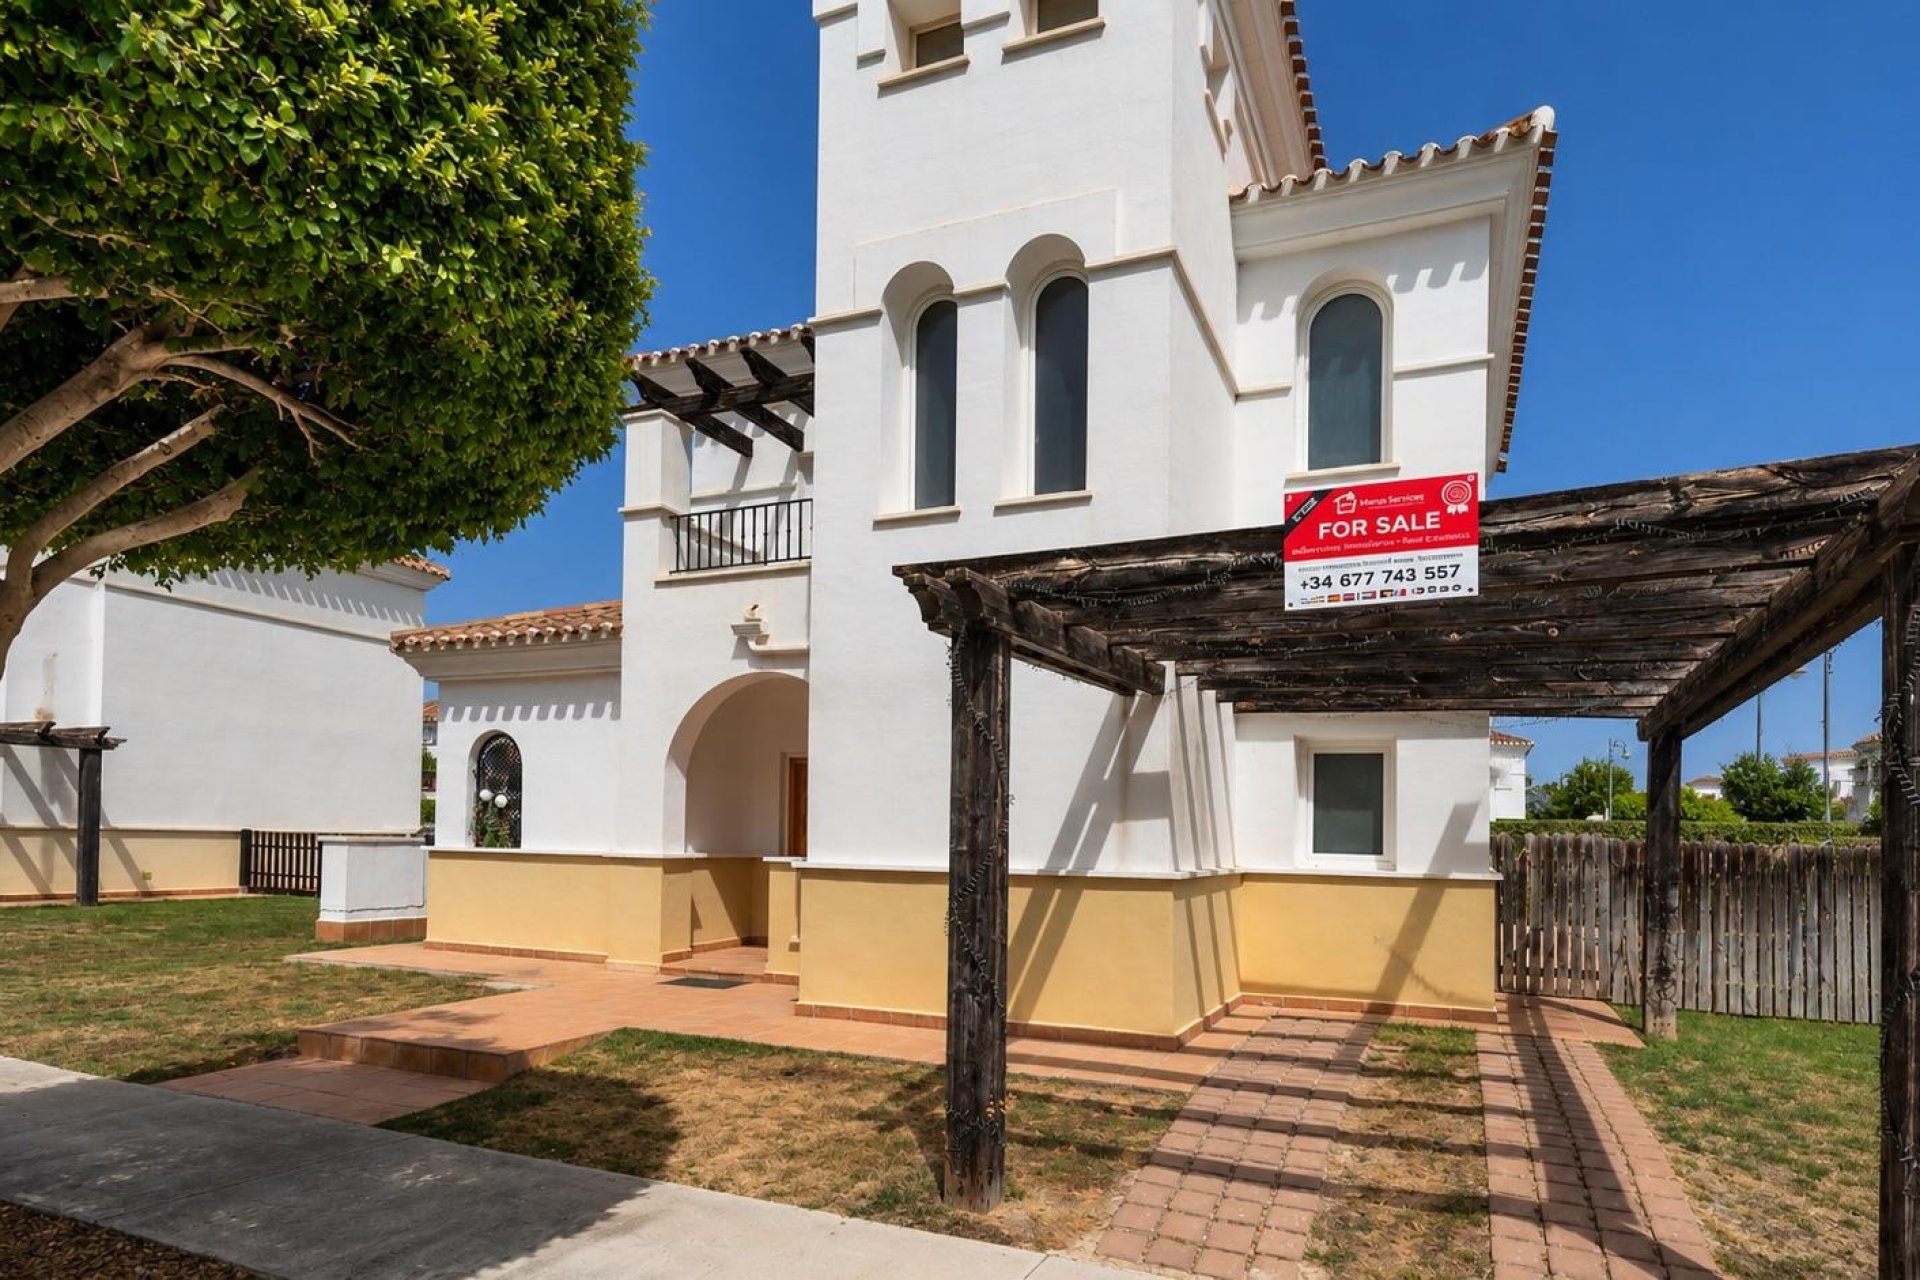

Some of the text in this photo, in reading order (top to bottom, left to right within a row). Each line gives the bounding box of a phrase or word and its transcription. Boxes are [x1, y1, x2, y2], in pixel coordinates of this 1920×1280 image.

[1318, 511, 1441, 540] FOR SALE
[1300, 564, 1461, 590] +34 677 743 557
